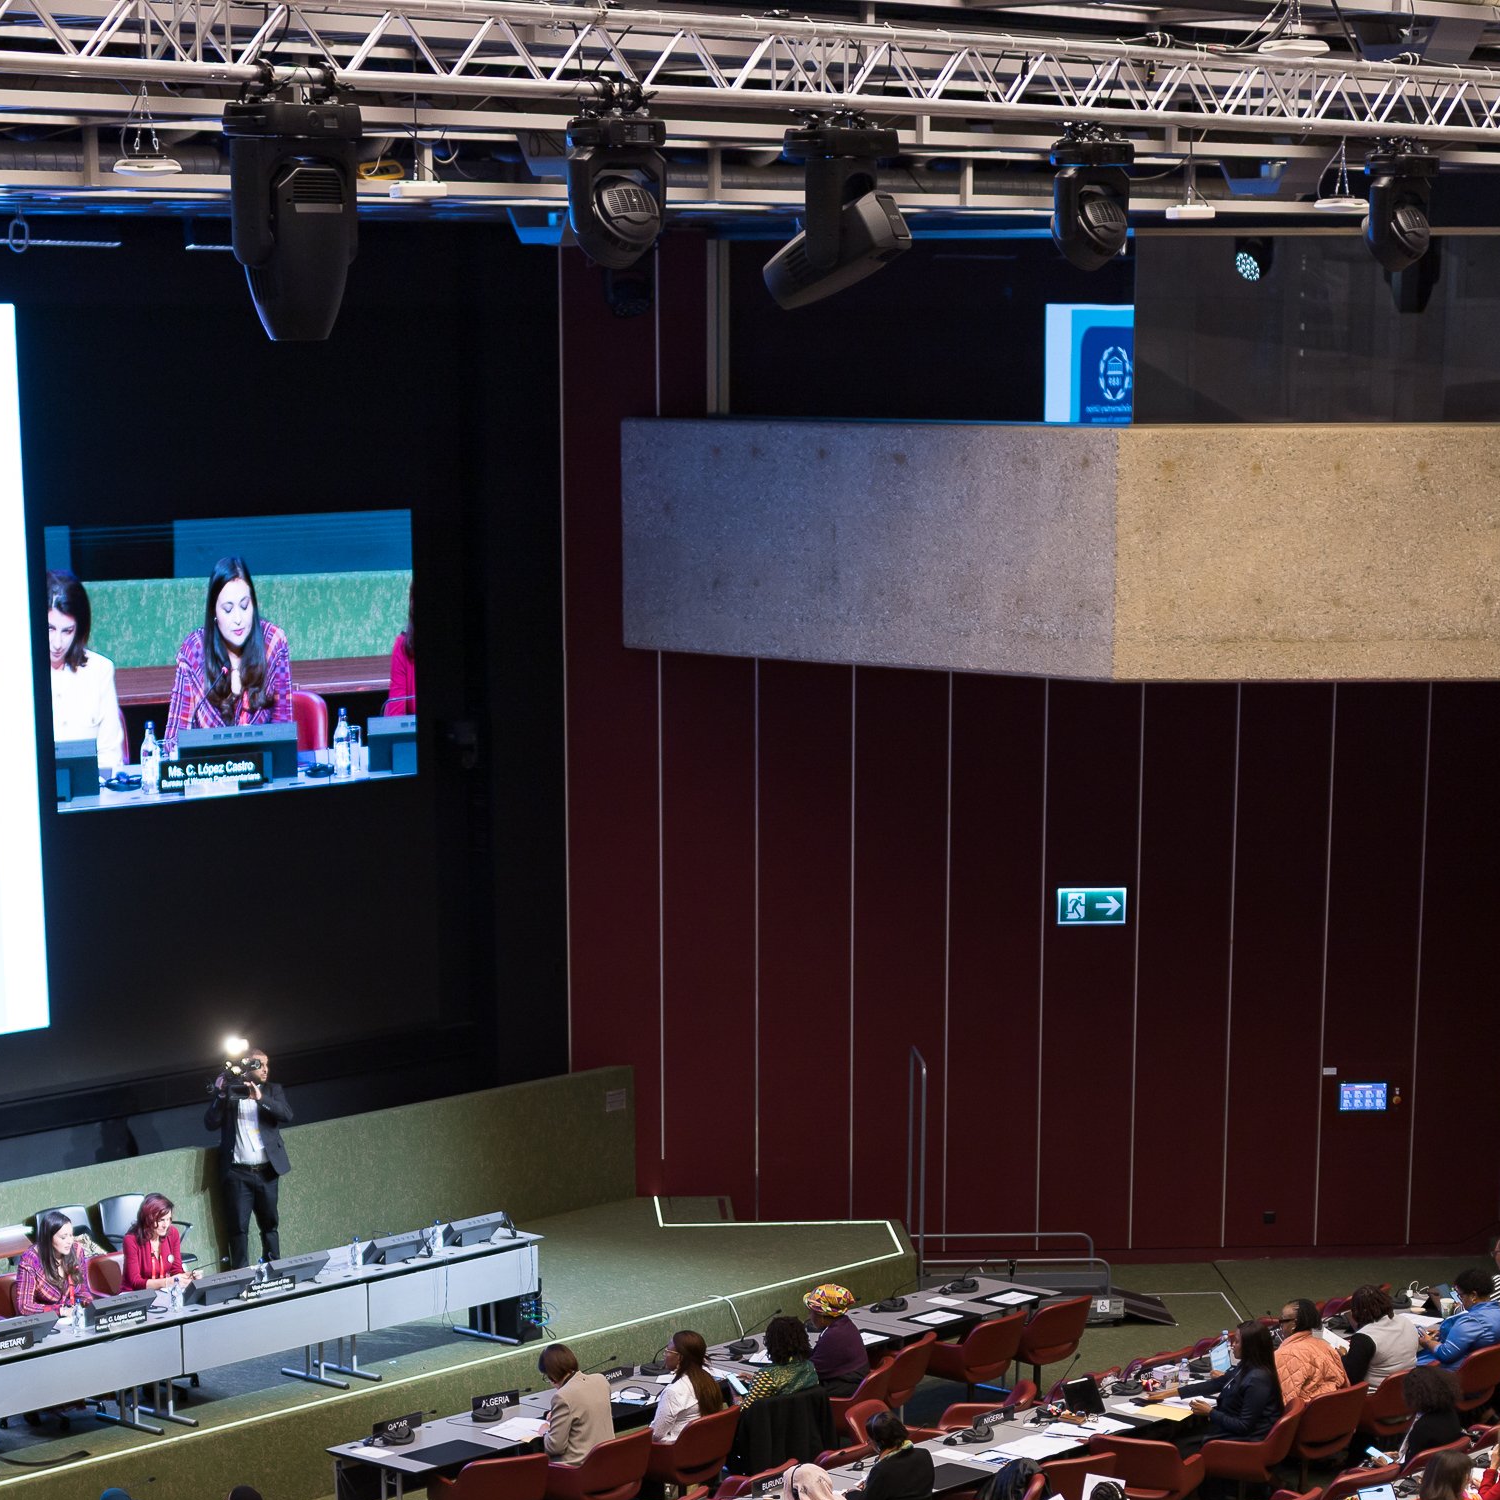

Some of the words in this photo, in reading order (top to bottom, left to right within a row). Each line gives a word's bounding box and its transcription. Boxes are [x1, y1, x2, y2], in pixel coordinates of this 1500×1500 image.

[167, 766, 185, 778] Ms.
[185, 764, 197, 776] C.
[198, 763, 225, 776] López
[225, 760, 255, 773] Castro
[161, 778, 183, 789] Bureau
[481, 1395, 510, 1408] ALGERIA
[983, 1412, 1005, 1424] NIGERIA
[387, 1419, 408, 1431] QAAR
[761, 1476, 784, 1491] BURUND
